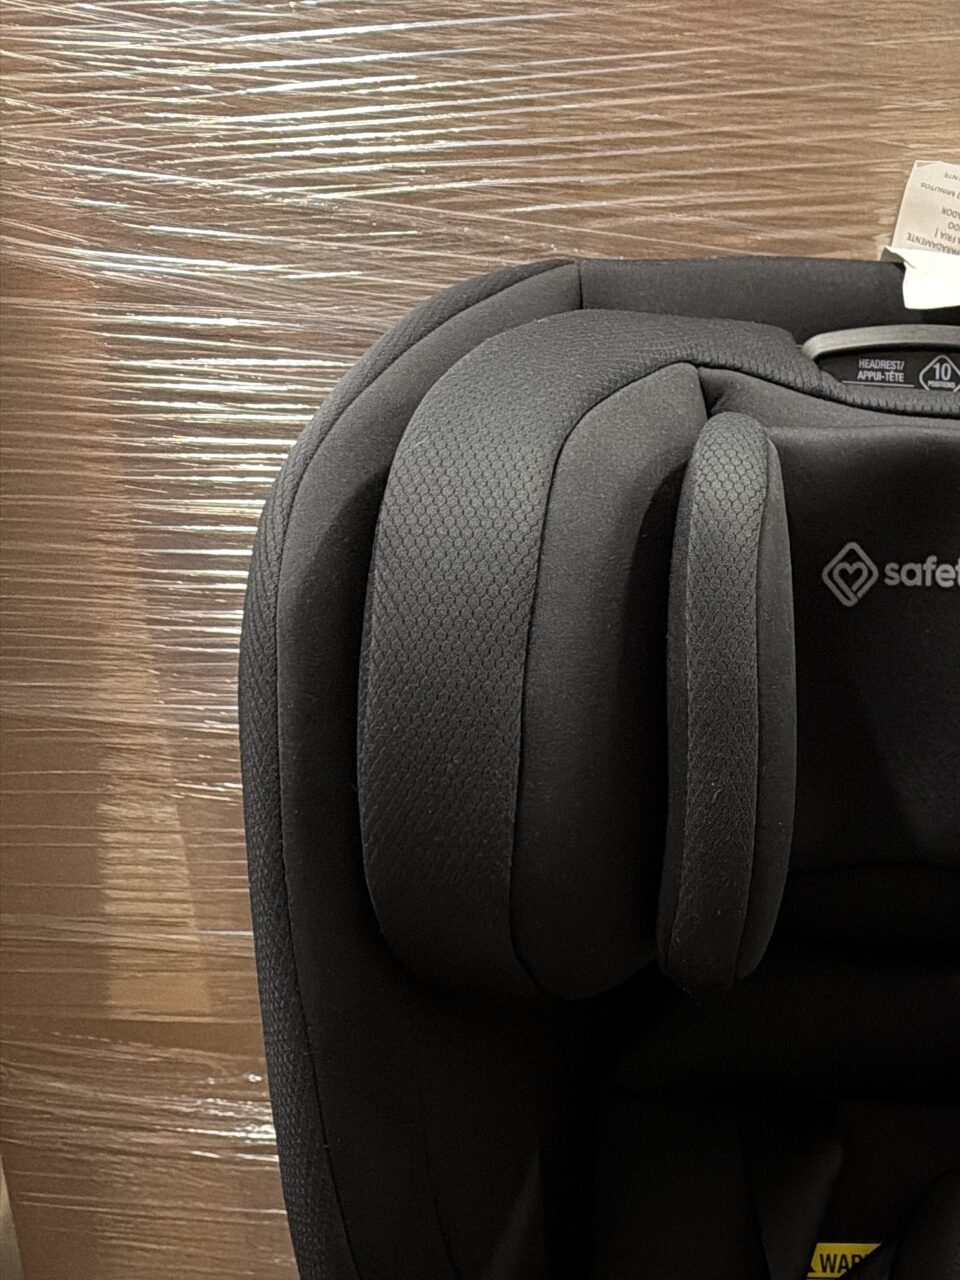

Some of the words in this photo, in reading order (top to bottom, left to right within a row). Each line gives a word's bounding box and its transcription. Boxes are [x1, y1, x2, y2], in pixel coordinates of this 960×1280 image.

[858, 358, 905, 371] HEADREST/
[857, 370, 905, 383] APPUI-TÊTE
[933, 362, 952, 381] 10
